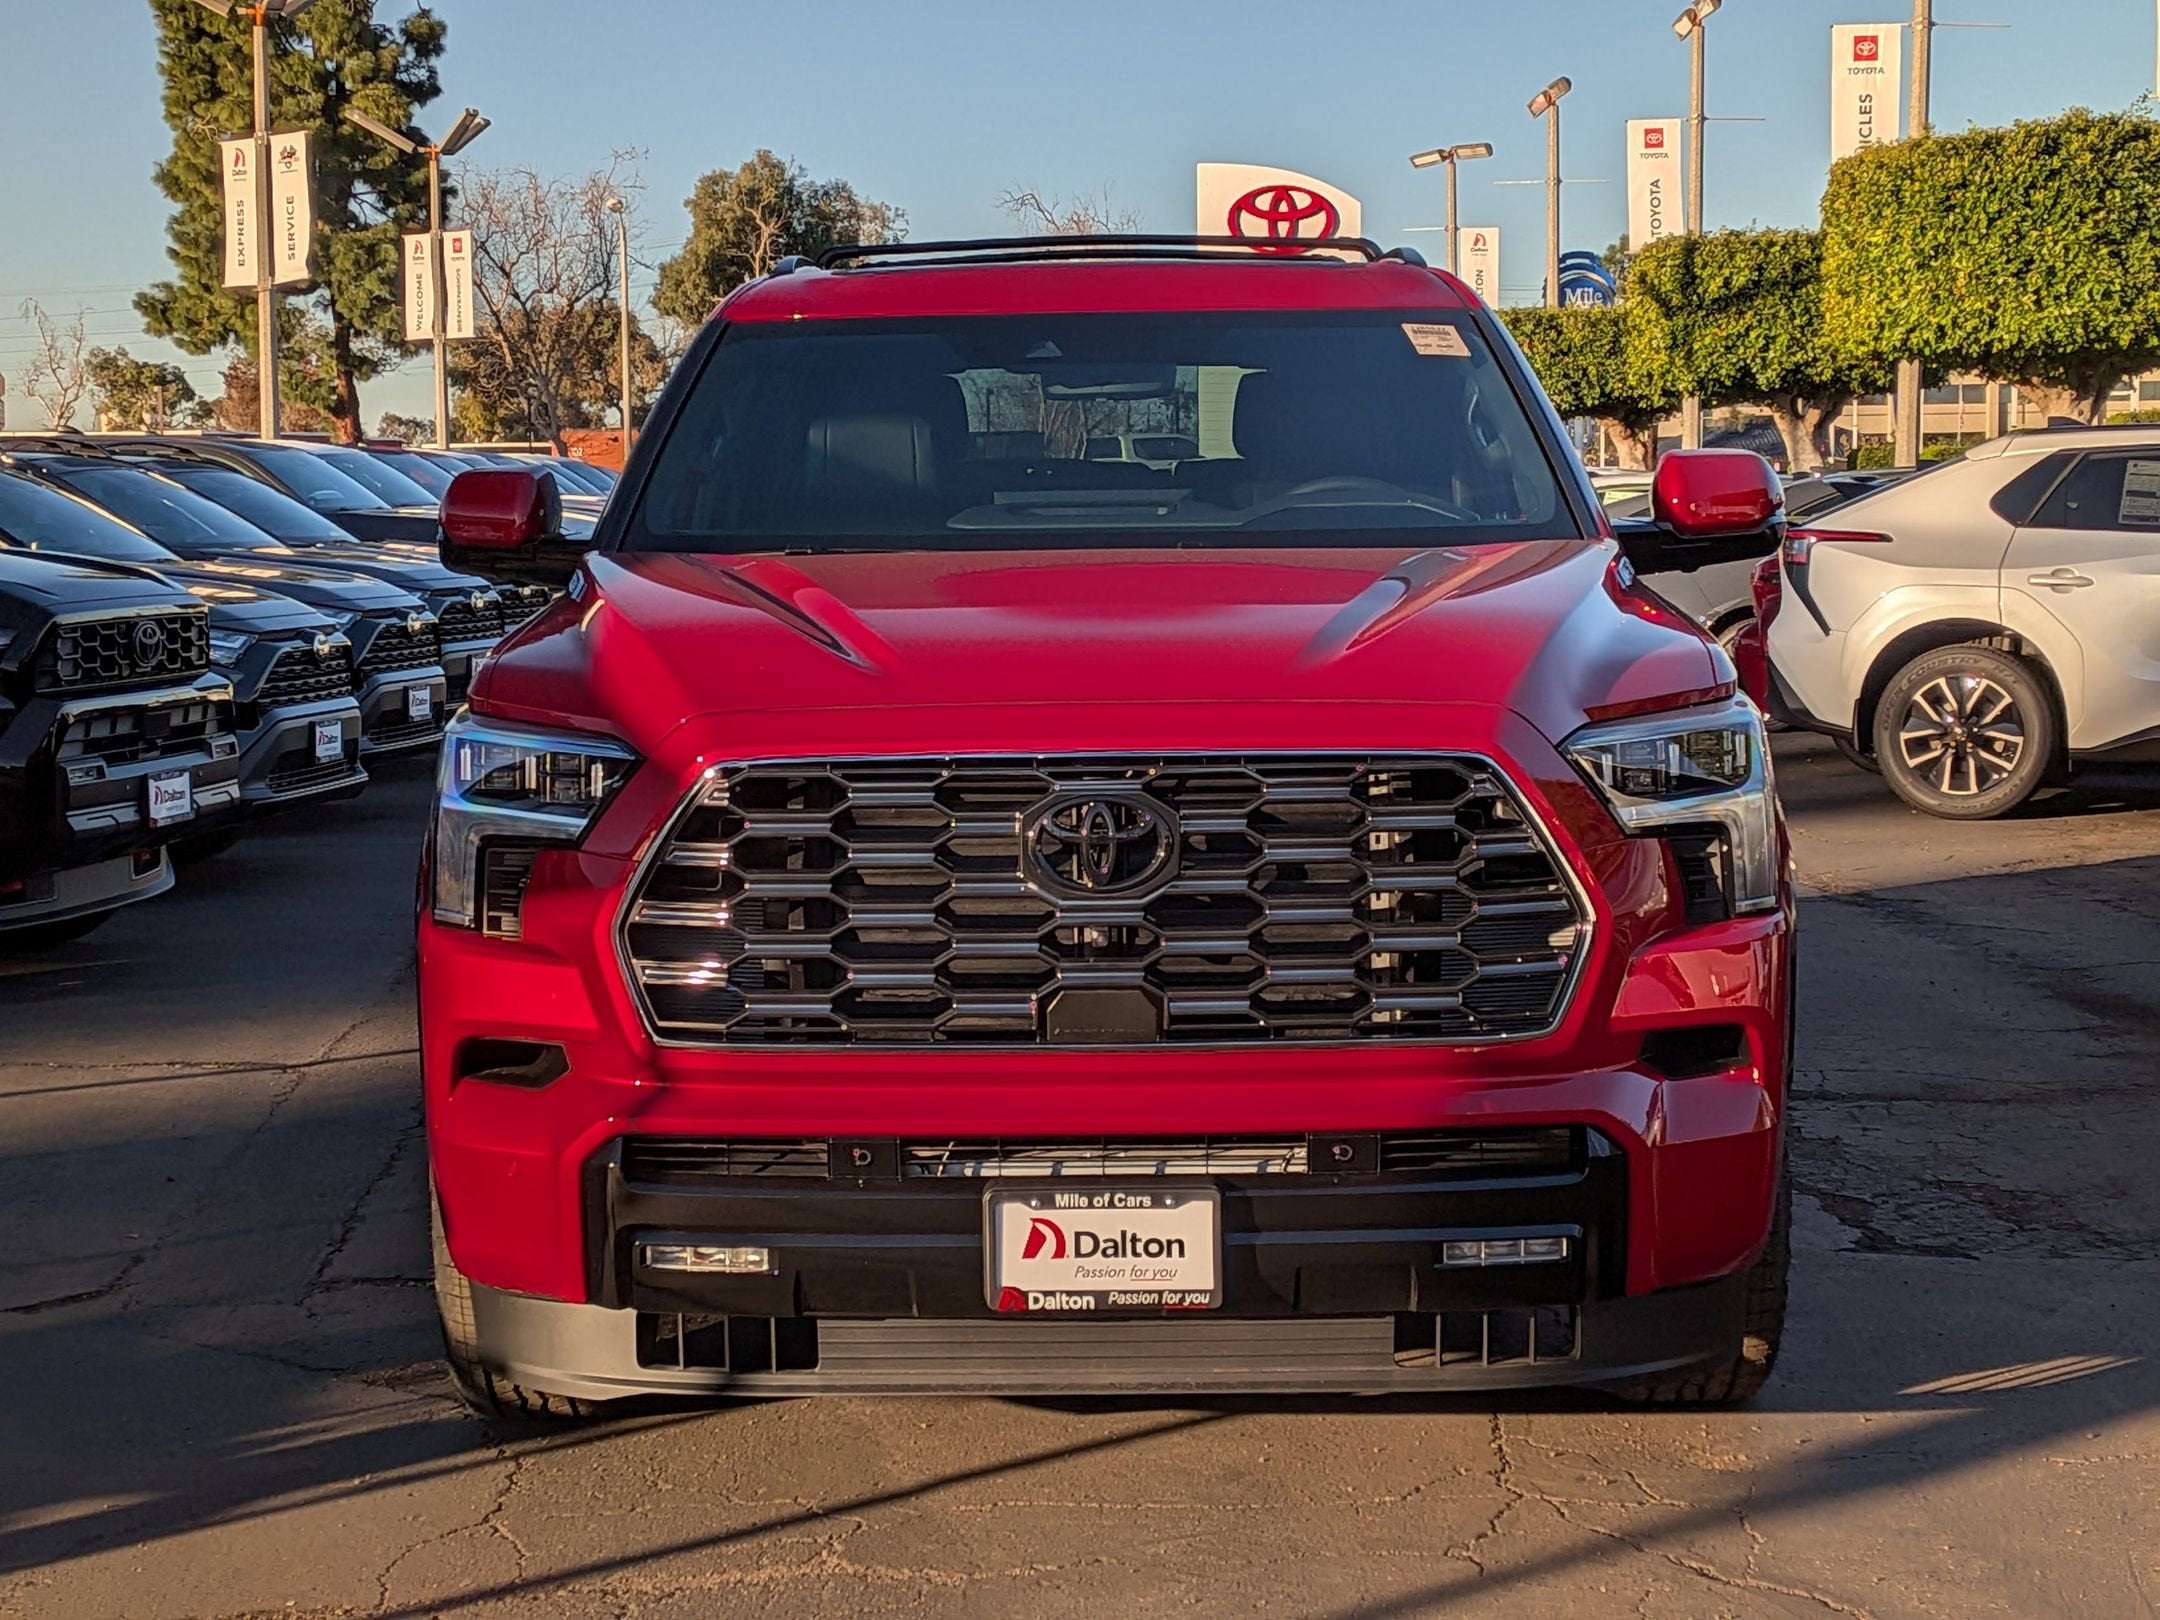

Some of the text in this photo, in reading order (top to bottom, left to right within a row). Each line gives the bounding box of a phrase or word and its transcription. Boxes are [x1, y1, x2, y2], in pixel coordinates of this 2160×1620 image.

[1847, 66, 1885, 75] TOYOTA
[1858, 93, 1872, 144] ICLES
[1650, 178, 1662, 238] TOYOTA
[236, 199, 245, 267] EXPRESS
[286, 195, 296, 261] SERVICE
[1475, 269, 1484, 296] LTON
[1564, 287, 1604, 305] Mile
[1055, 1193, 1152, 1208] Mile of Cars
[1074, 1230, 1186, 1259] Dalton
[1074, 1264, 1177, 1281] Passion for you
[1028, 1292, 1095, 1311] Dalton
[1108, 1290, 1210, 1307] Passion for you
